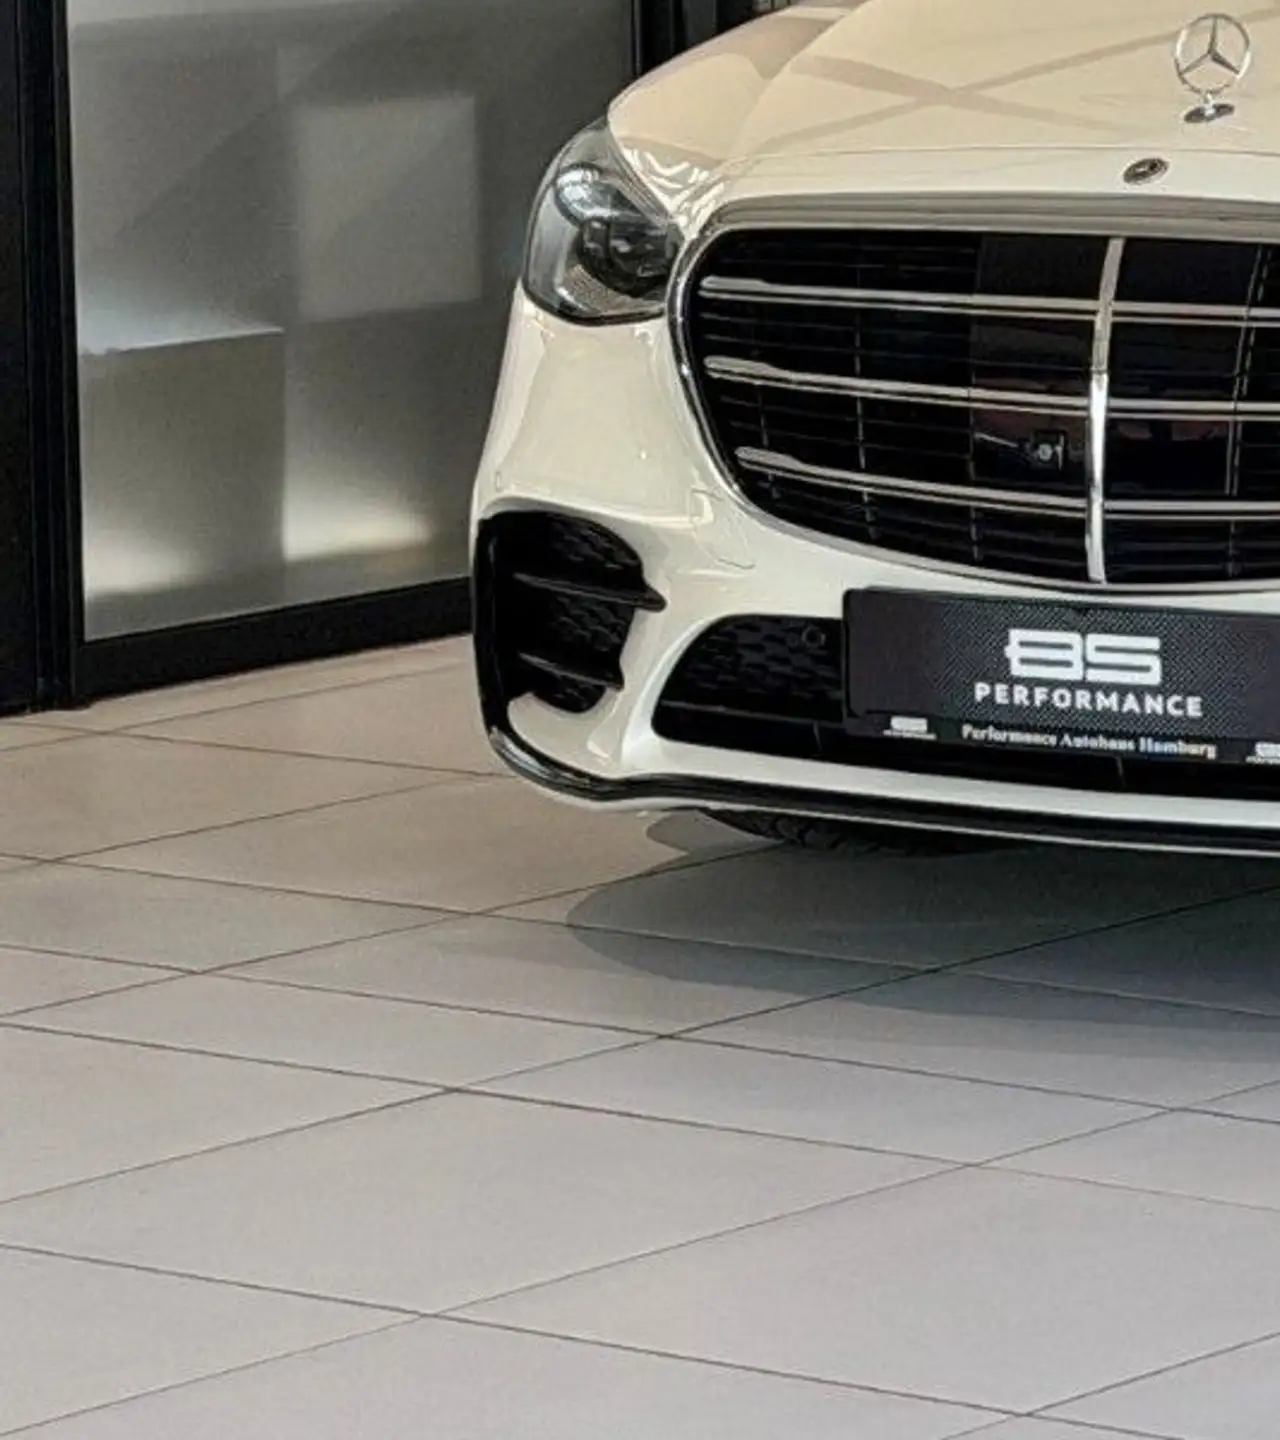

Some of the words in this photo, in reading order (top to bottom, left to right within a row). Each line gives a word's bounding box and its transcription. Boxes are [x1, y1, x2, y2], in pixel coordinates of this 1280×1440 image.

[1005, 628, 1161, 685] BS
[974, 682, 1204, 719] PERFORMANCE
[961, 723, 1058, 747] Performance
[1060, 733, 1136, 752] Autohaus
[1139, 736, 1218, 760] Hamburg
